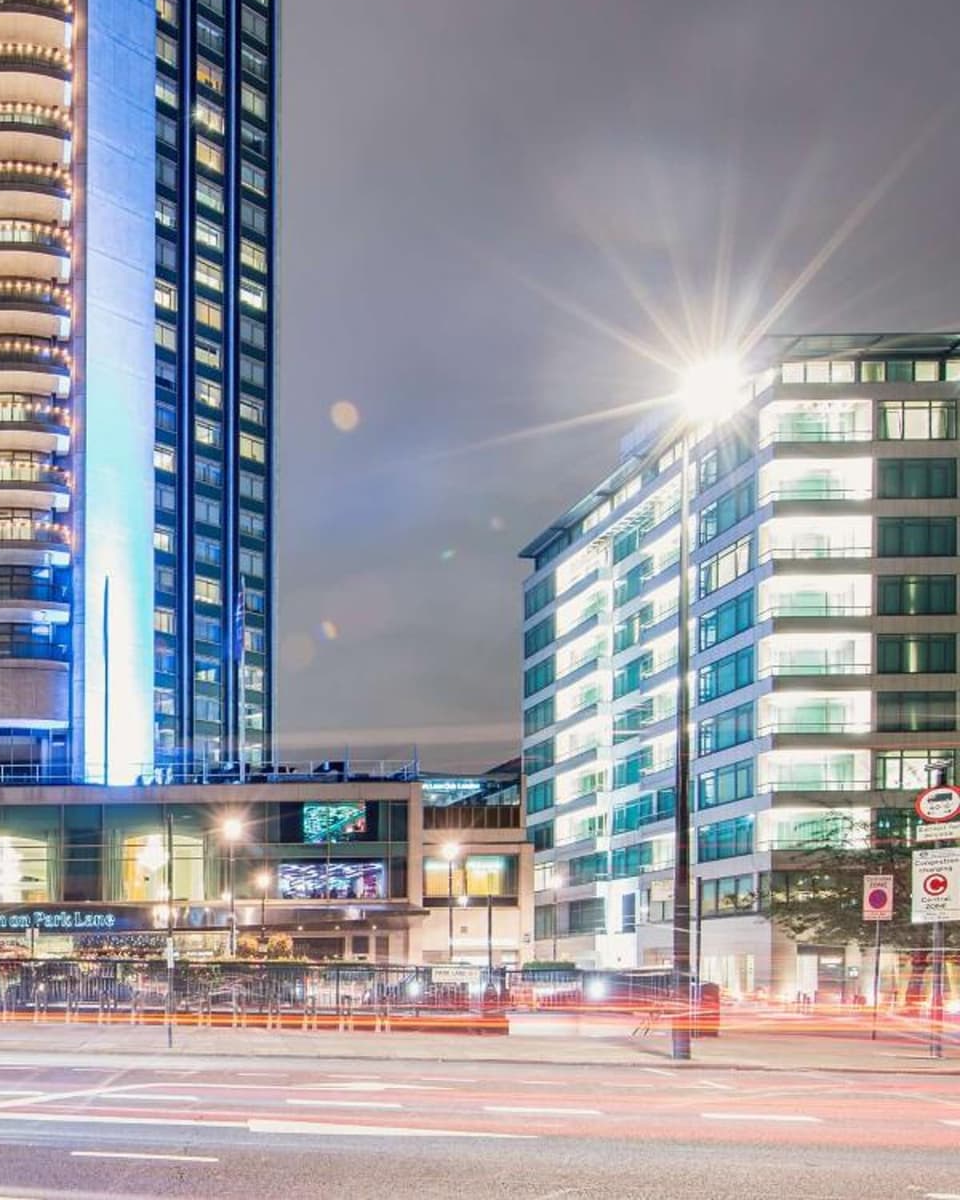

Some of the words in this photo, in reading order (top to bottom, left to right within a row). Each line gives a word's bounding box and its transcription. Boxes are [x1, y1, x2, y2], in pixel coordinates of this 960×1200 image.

[8, 915, 31, 928] on
[32, 911, 72, 927] Park
[74, 911, 116, 927] Lane
